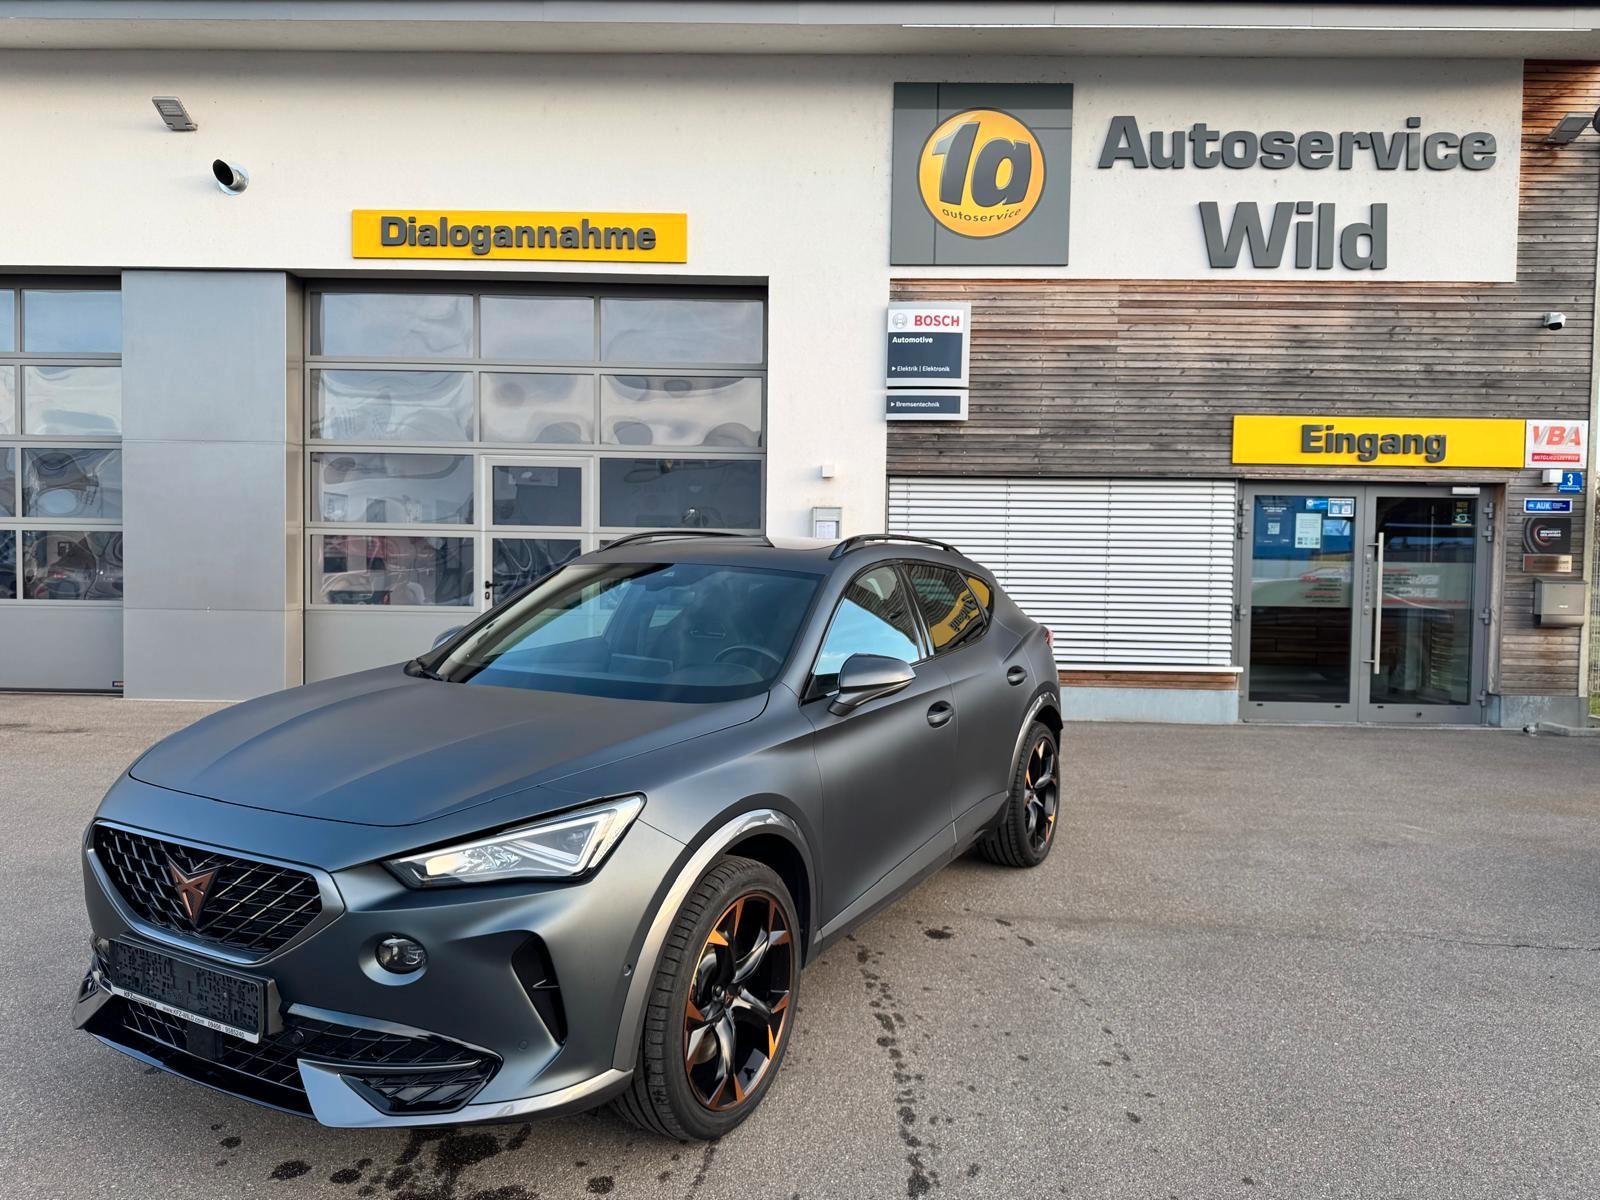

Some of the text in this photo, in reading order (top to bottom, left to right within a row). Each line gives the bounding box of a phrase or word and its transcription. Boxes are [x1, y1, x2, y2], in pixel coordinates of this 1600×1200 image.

[1098, 115, 1497, 171] Autoservice
[932, 121, 1032, 208] 1a
[942, 208, 1021, 222] autoservice
[380, 216, 656, 255] Dialogannahme
[1199, 201, 1388, 270] Wild
[914, 315, 960, 327] BOSCH
[892, 336, 934, 344] Automotive
[1301, 424, 1447, 463] Eingang
[1533, 426, 1581, 446] VBA
[1567, 473, 1574, 486] 3
